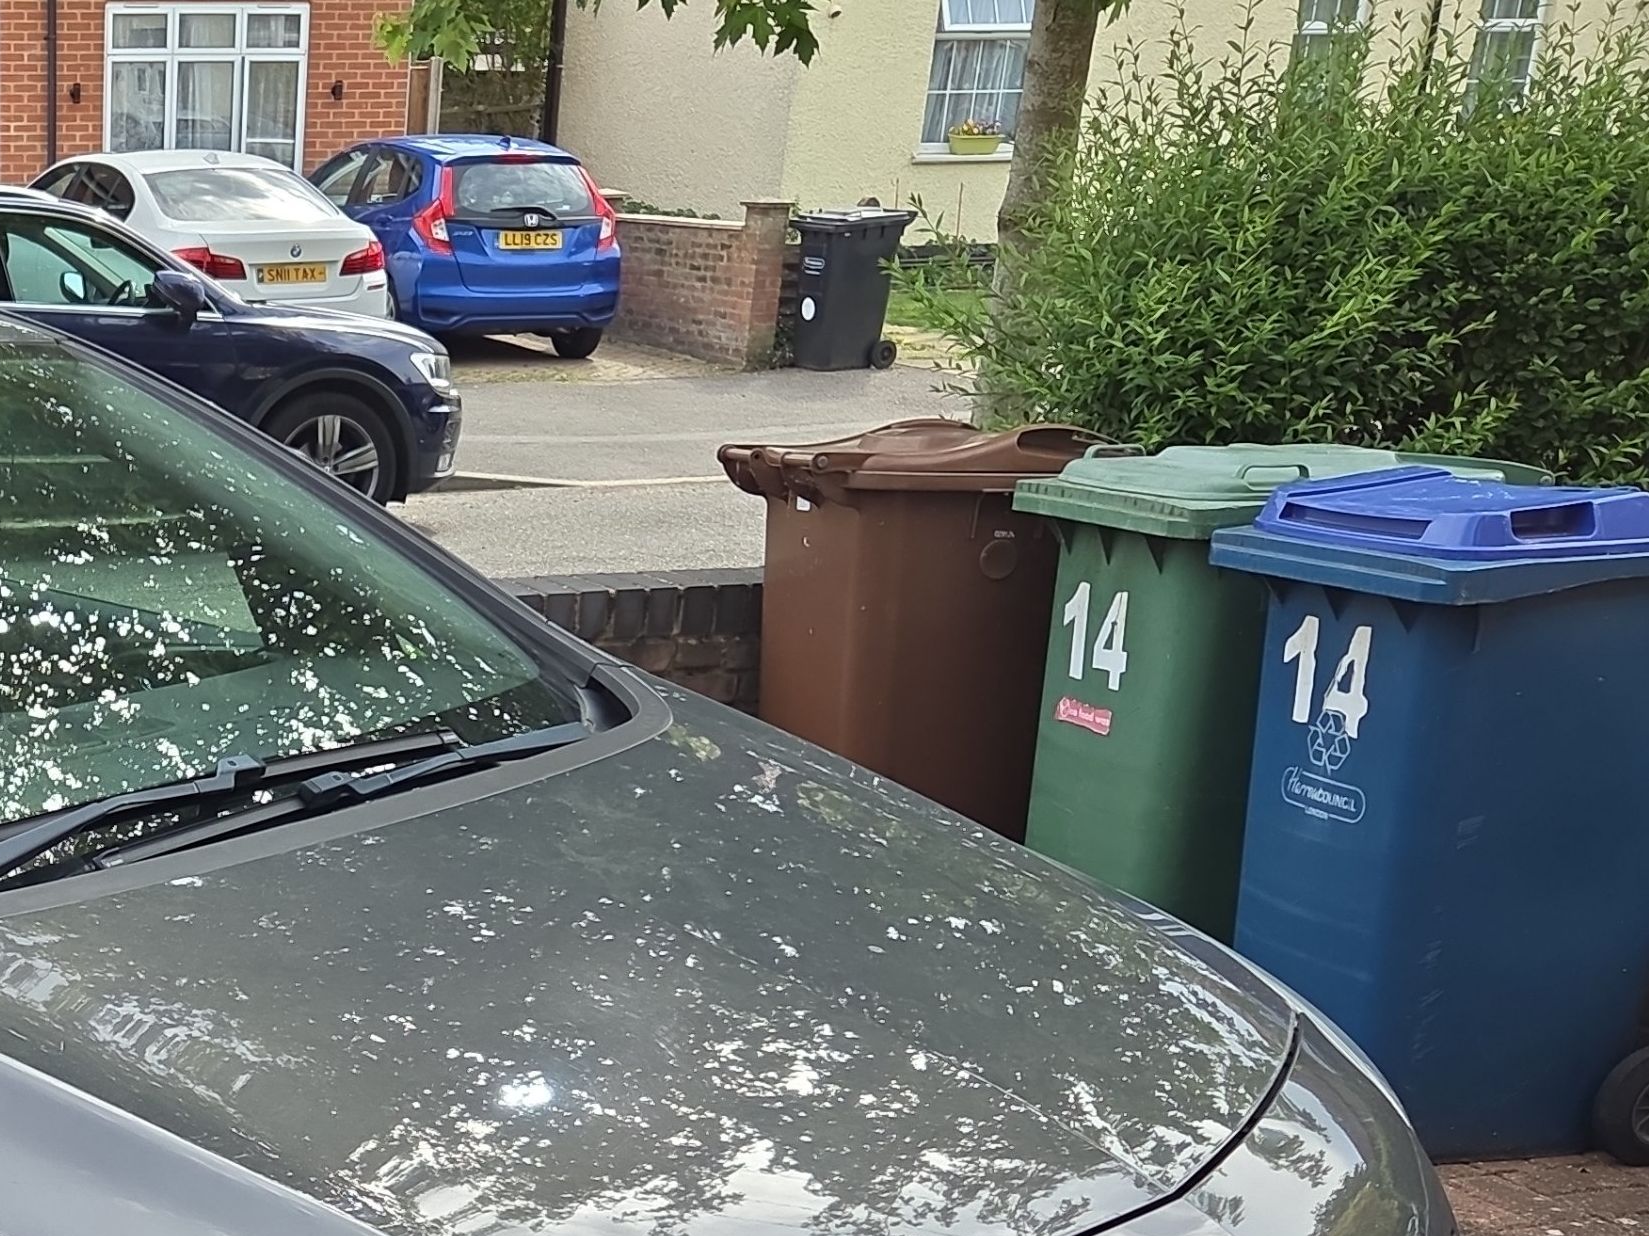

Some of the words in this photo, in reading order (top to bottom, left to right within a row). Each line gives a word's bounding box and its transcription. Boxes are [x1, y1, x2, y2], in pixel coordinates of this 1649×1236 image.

[504, 232, 531, 246] LL19
[535, 232, 558, 246] CZS
[293, 267, 316, 281] TAX
[1063, 581, 1128, 691] 14
[1284, 615, 1372, 739] 14
